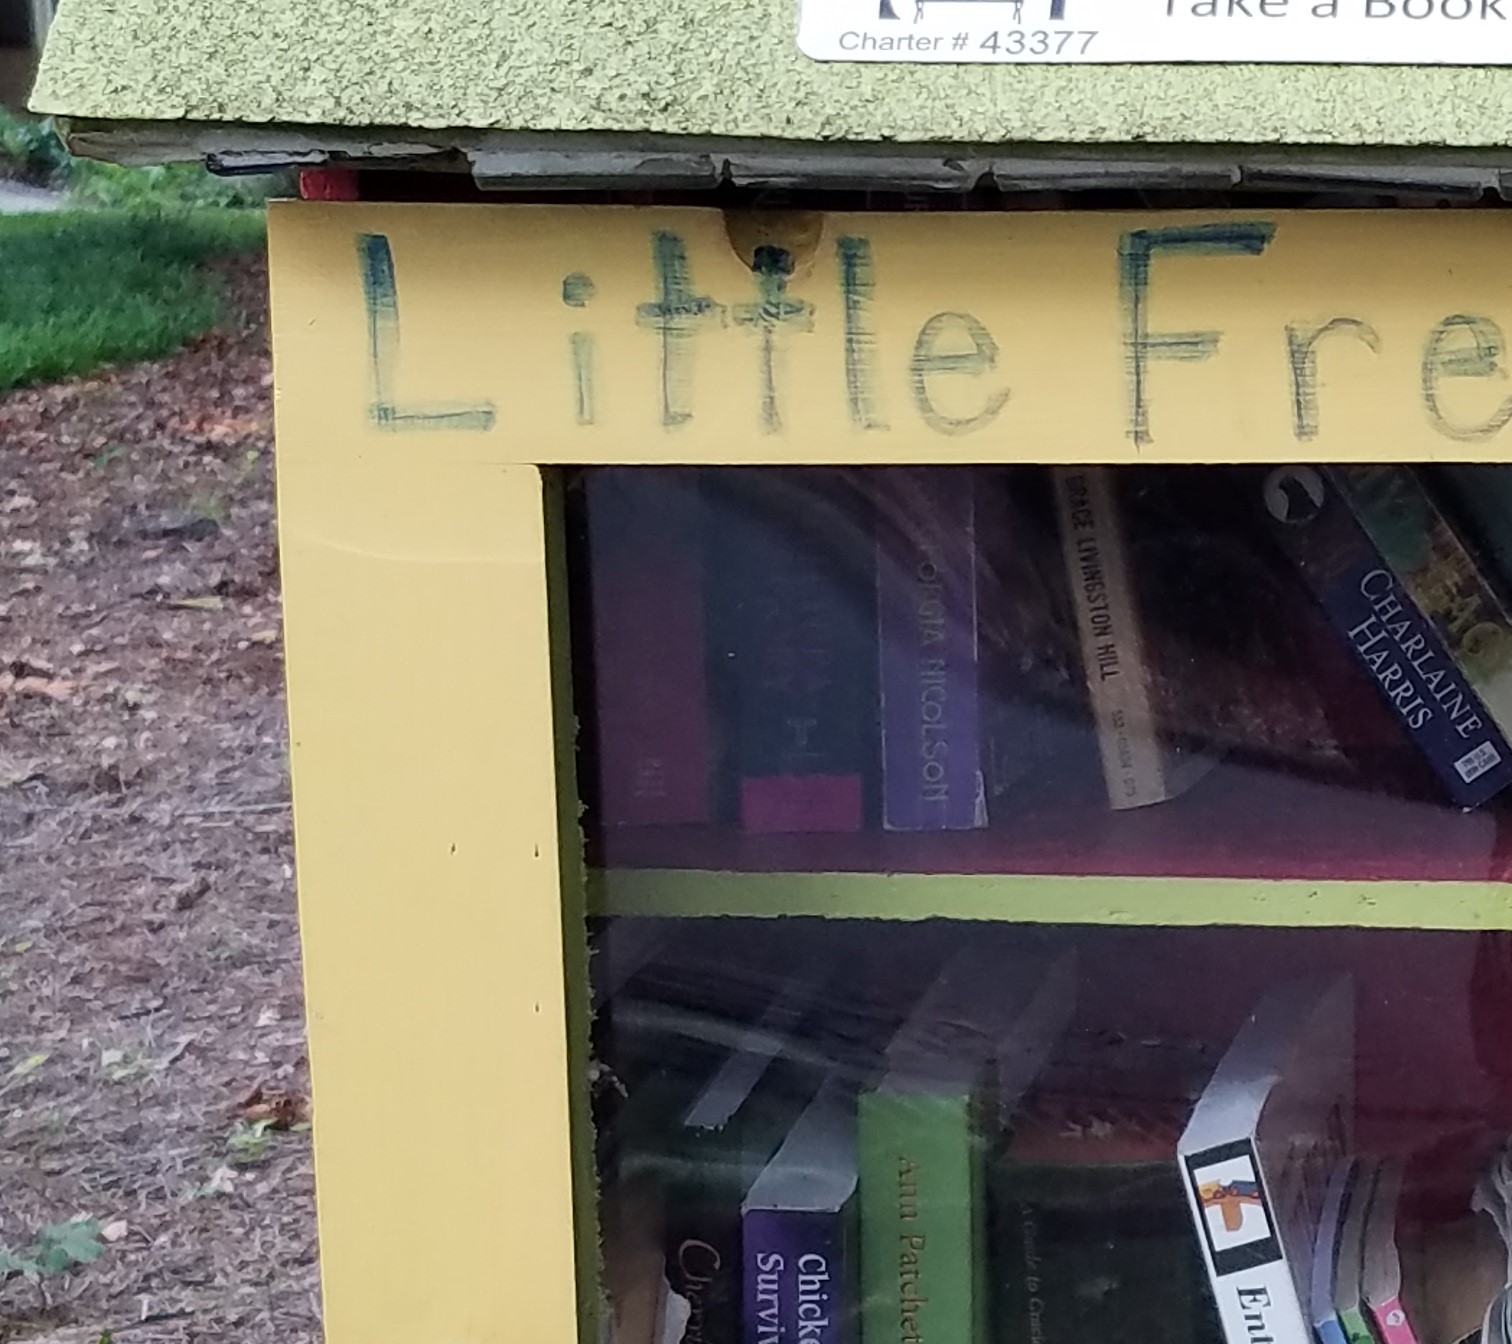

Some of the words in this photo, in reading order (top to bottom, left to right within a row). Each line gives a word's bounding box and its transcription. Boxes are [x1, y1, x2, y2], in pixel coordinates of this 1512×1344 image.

[838, 31, 944, 52] Charter
[951, 32, 969, 52] #
[979, 29, 1100, 56] 43377
[356, 229, 1010, 436] Little
[1065, 475, 1094, 530] GRACE
[1077, 537, 1114, 637] LIVINGSTON
[1097, 643, 1118, 682] HILL
[1347, 616, 1434, 731] HARRIS
[1360, 569, 1483, 739] CHARLAINE
[919, 659, 950, 803] NICOLSON
[899, 1156, 921, 1222] Ann
